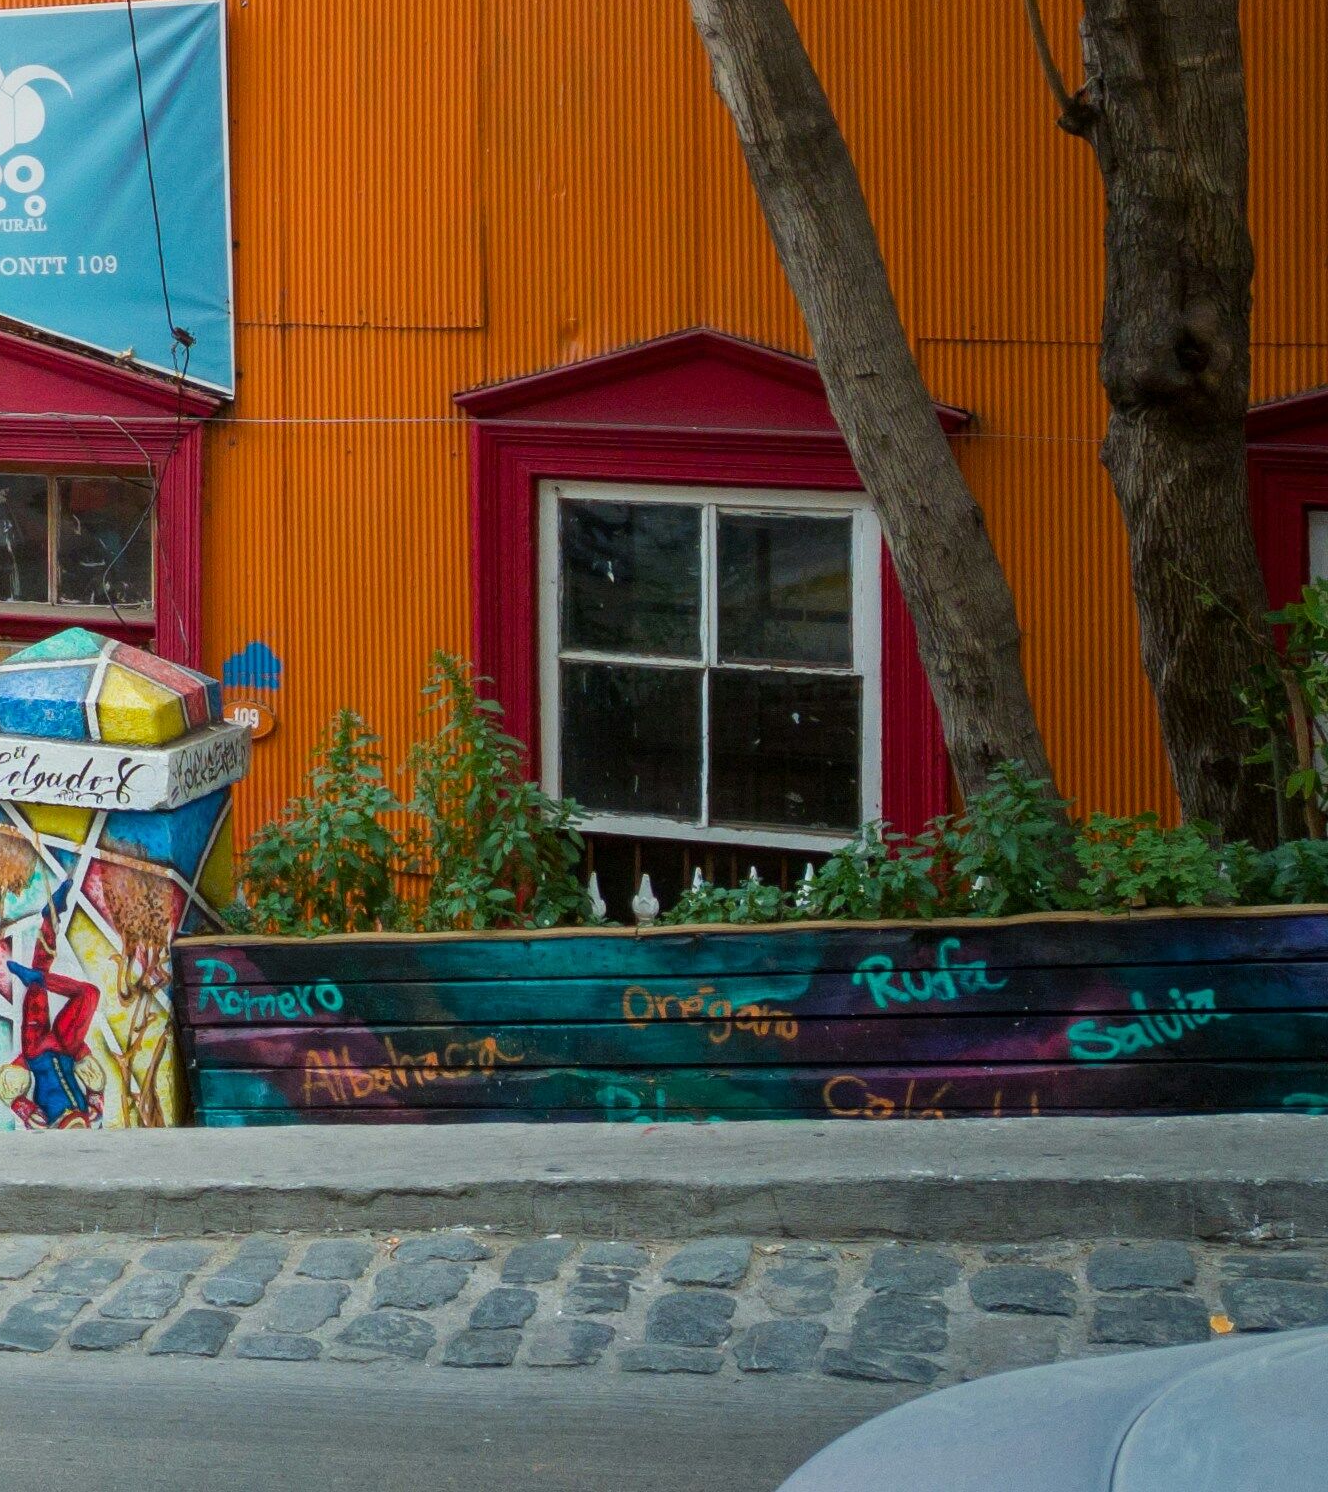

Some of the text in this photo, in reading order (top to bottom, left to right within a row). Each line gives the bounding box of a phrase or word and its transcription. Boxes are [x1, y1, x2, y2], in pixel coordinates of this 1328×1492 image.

[77, 255, 119, 275] 109
[233, 707, 260, 729] 109
[194, 957, 344, 1021] Romero
[1066, 988, 1233, 1065] Salvia
